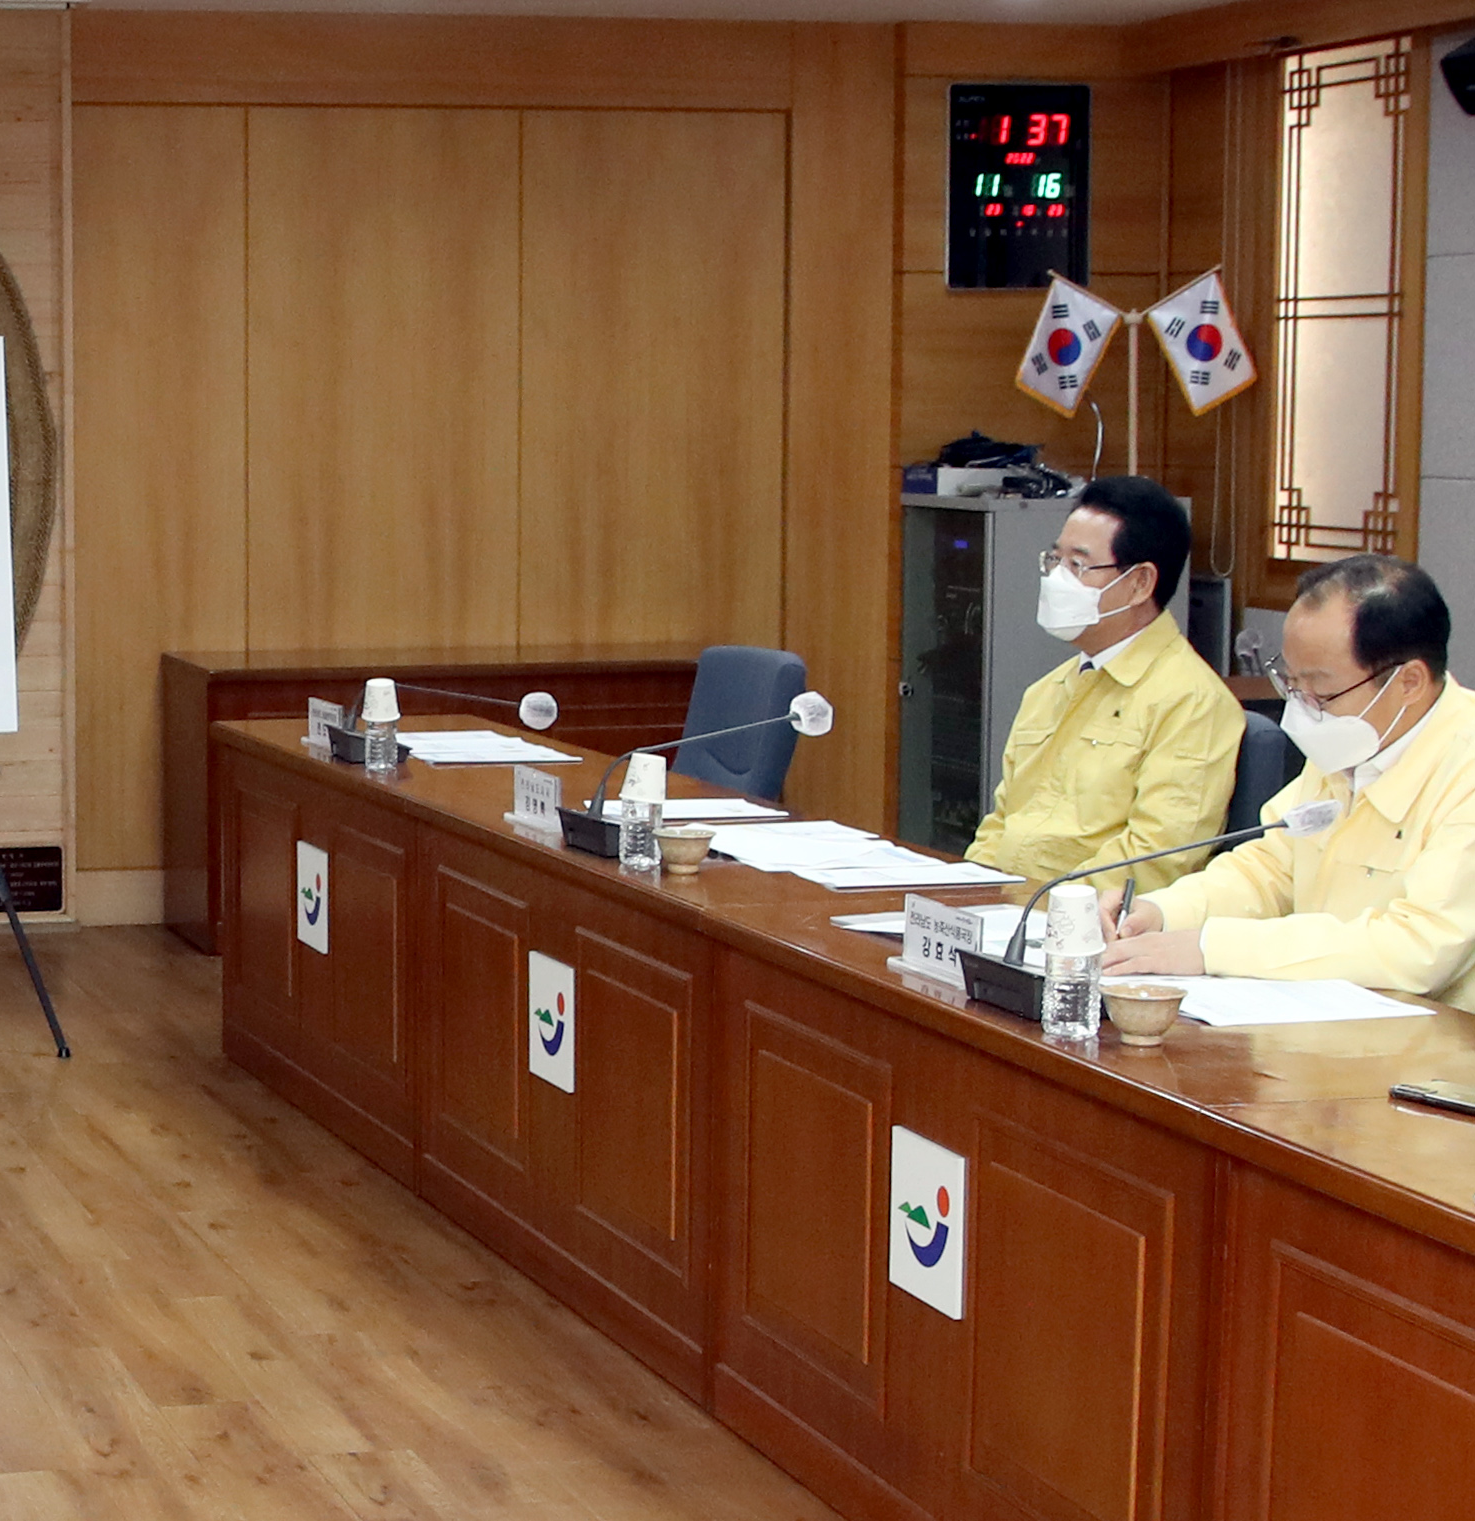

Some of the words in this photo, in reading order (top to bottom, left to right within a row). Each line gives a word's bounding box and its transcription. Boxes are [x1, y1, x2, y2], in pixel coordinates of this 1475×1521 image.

[999, 115, 1010, 145] 1
[1027, 113, 1071, 146] 37
[975, 173, 1001, 197] 11
[1037, 172, 1062, 199] 16
